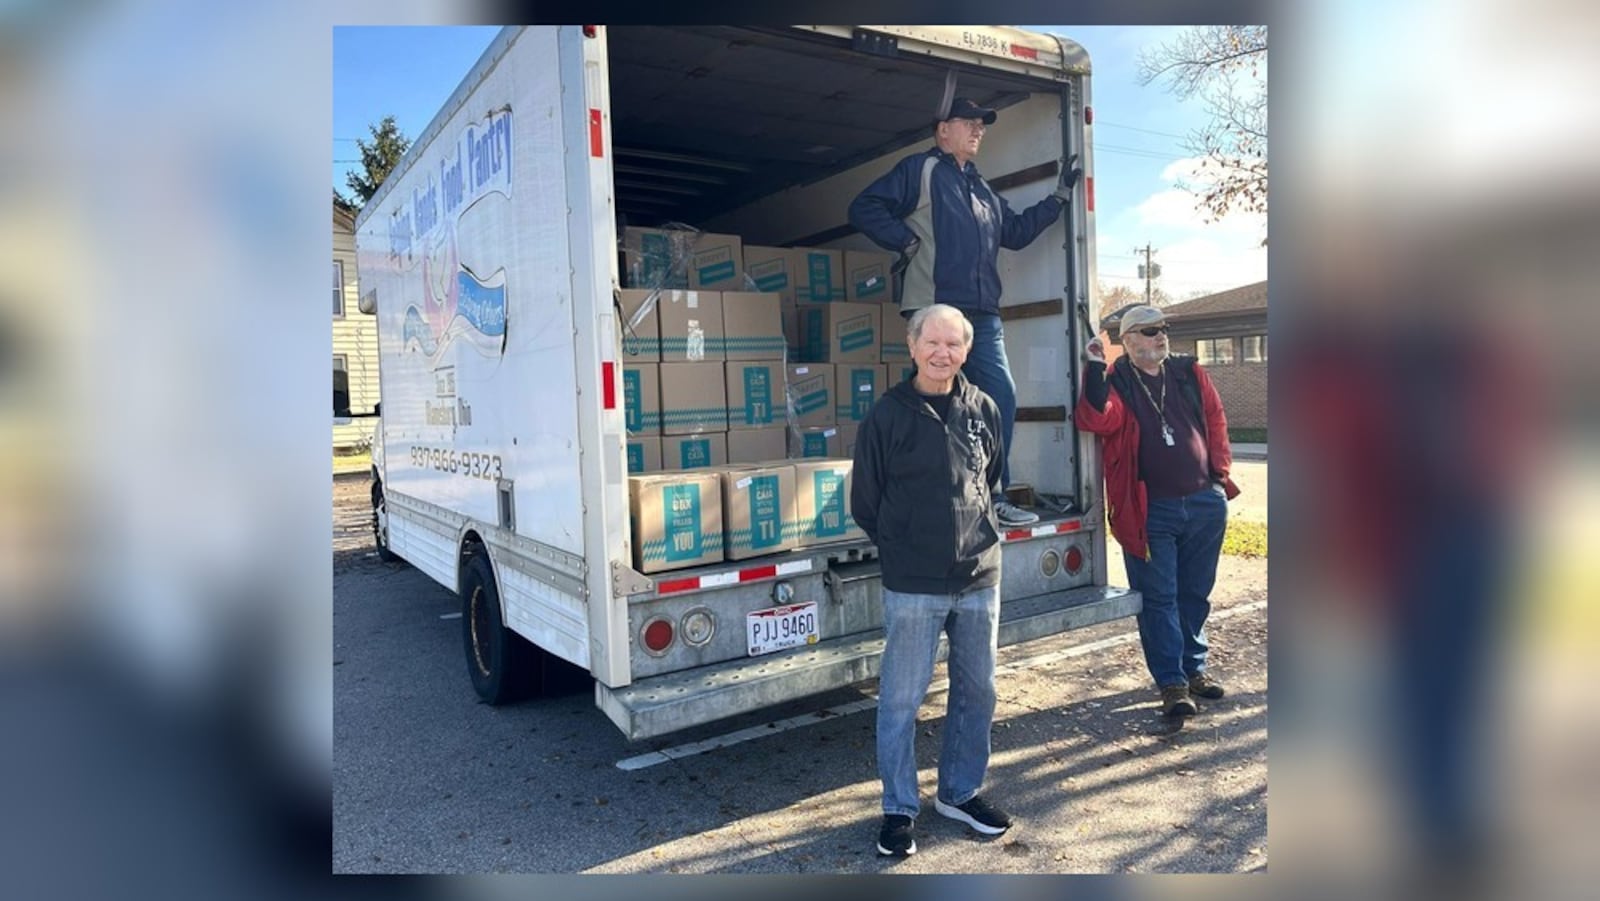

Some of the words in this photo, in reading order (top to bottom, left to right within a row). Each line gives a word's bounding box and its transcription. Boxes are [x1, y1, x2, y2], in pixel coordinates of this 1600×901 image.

[440, 141, 462, 216] Food
[468, 112, 511, 193] Pantry
[411, 446, 503, 481] 937-866-9323
[759, 519, 775, 540] TI
[822, 511, 839, 528] YOU
[673, 531, 694, 552] YOU
[753, 619, 778, 644] PJJ
[782, 612, 814, 638] 9460
